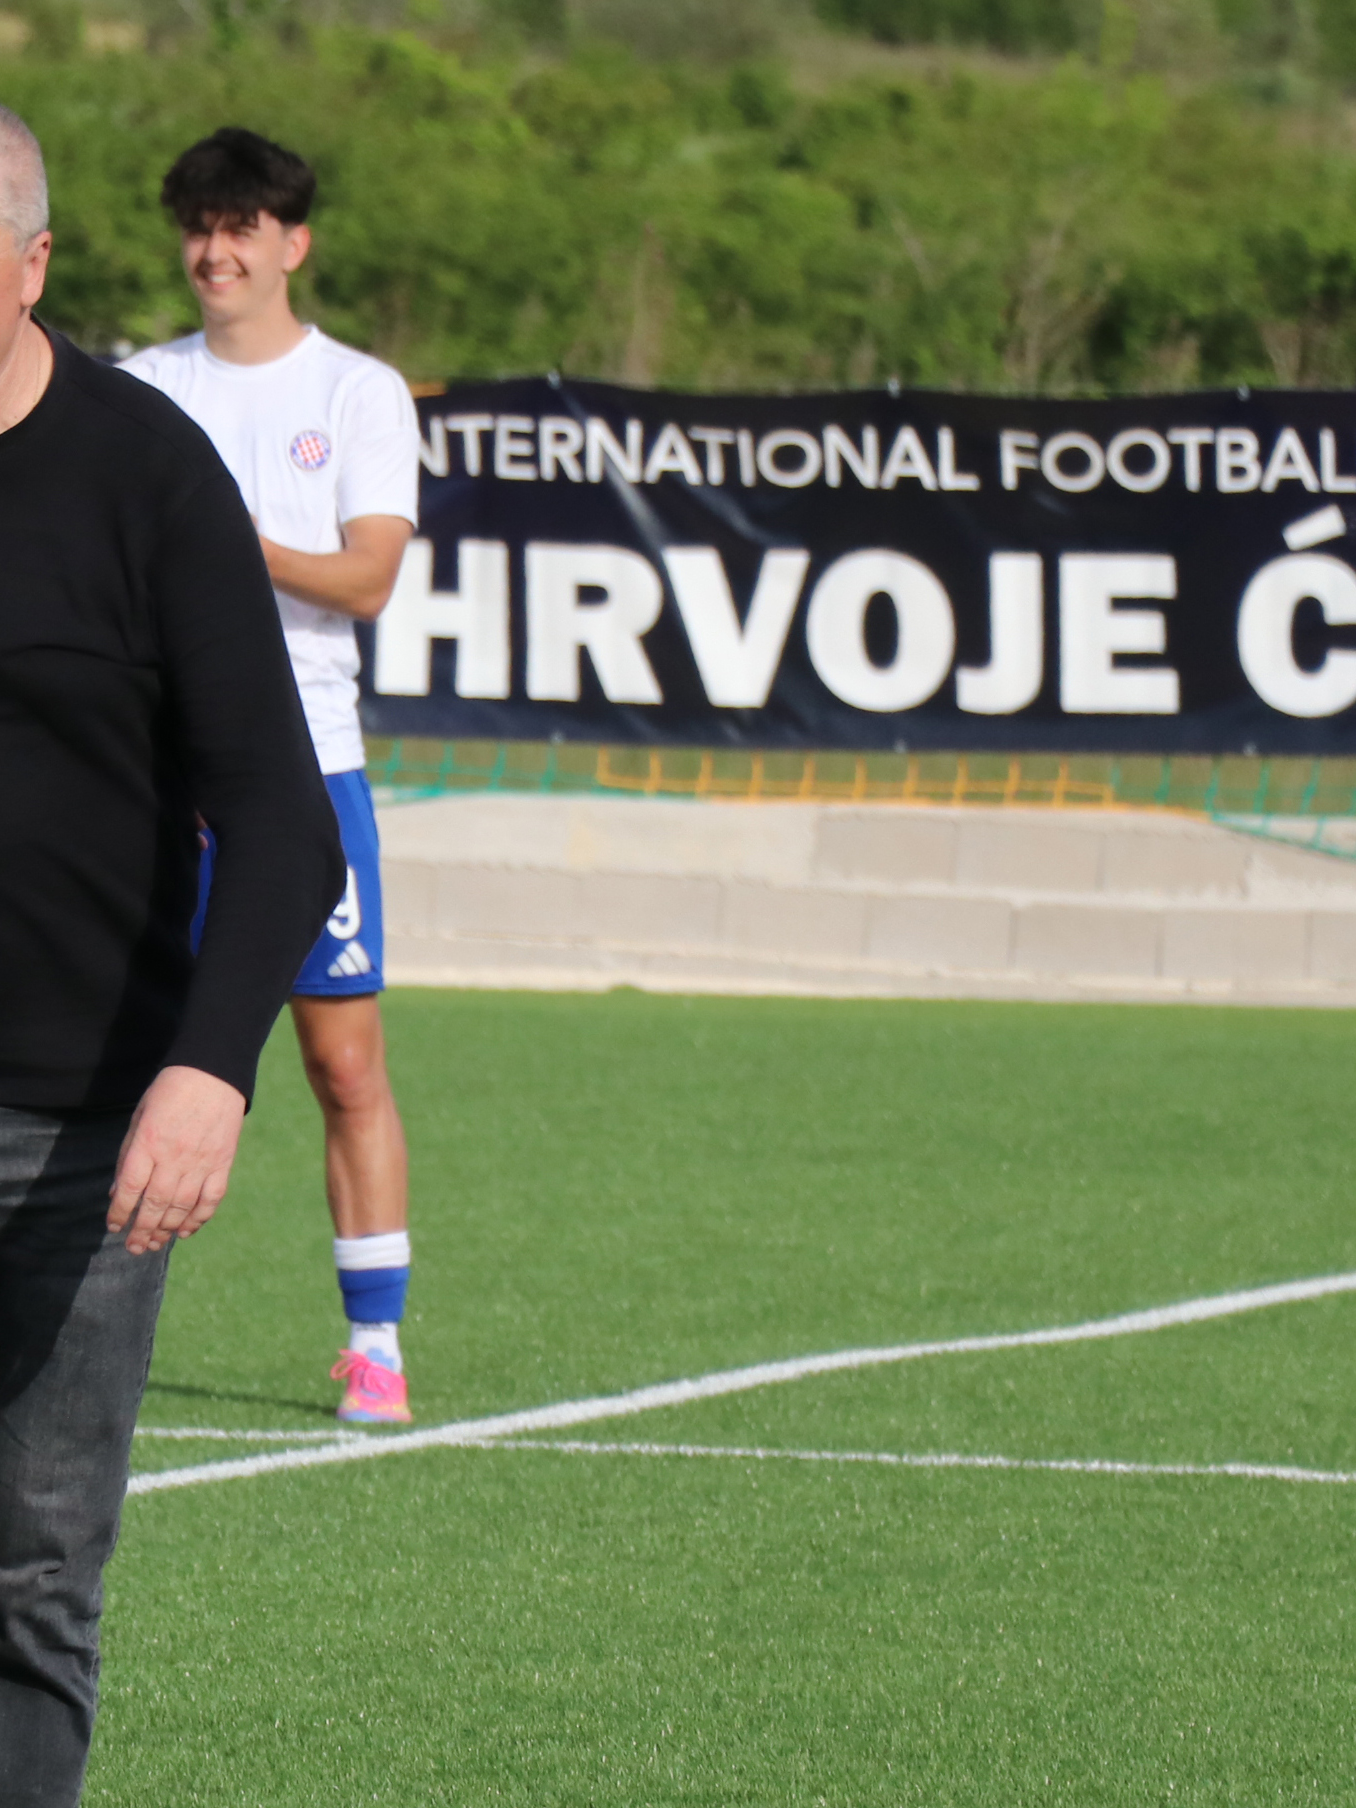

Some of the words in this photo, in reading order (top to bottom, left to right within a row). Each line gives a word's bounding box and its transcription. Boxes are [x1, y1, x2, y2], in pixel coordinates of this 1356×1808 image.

[1000, 426, 1356, 494] FOOTBAL
[375, 537, 1181, 715] HRVOJE
[1237, 503, 1356, 718] Ć
